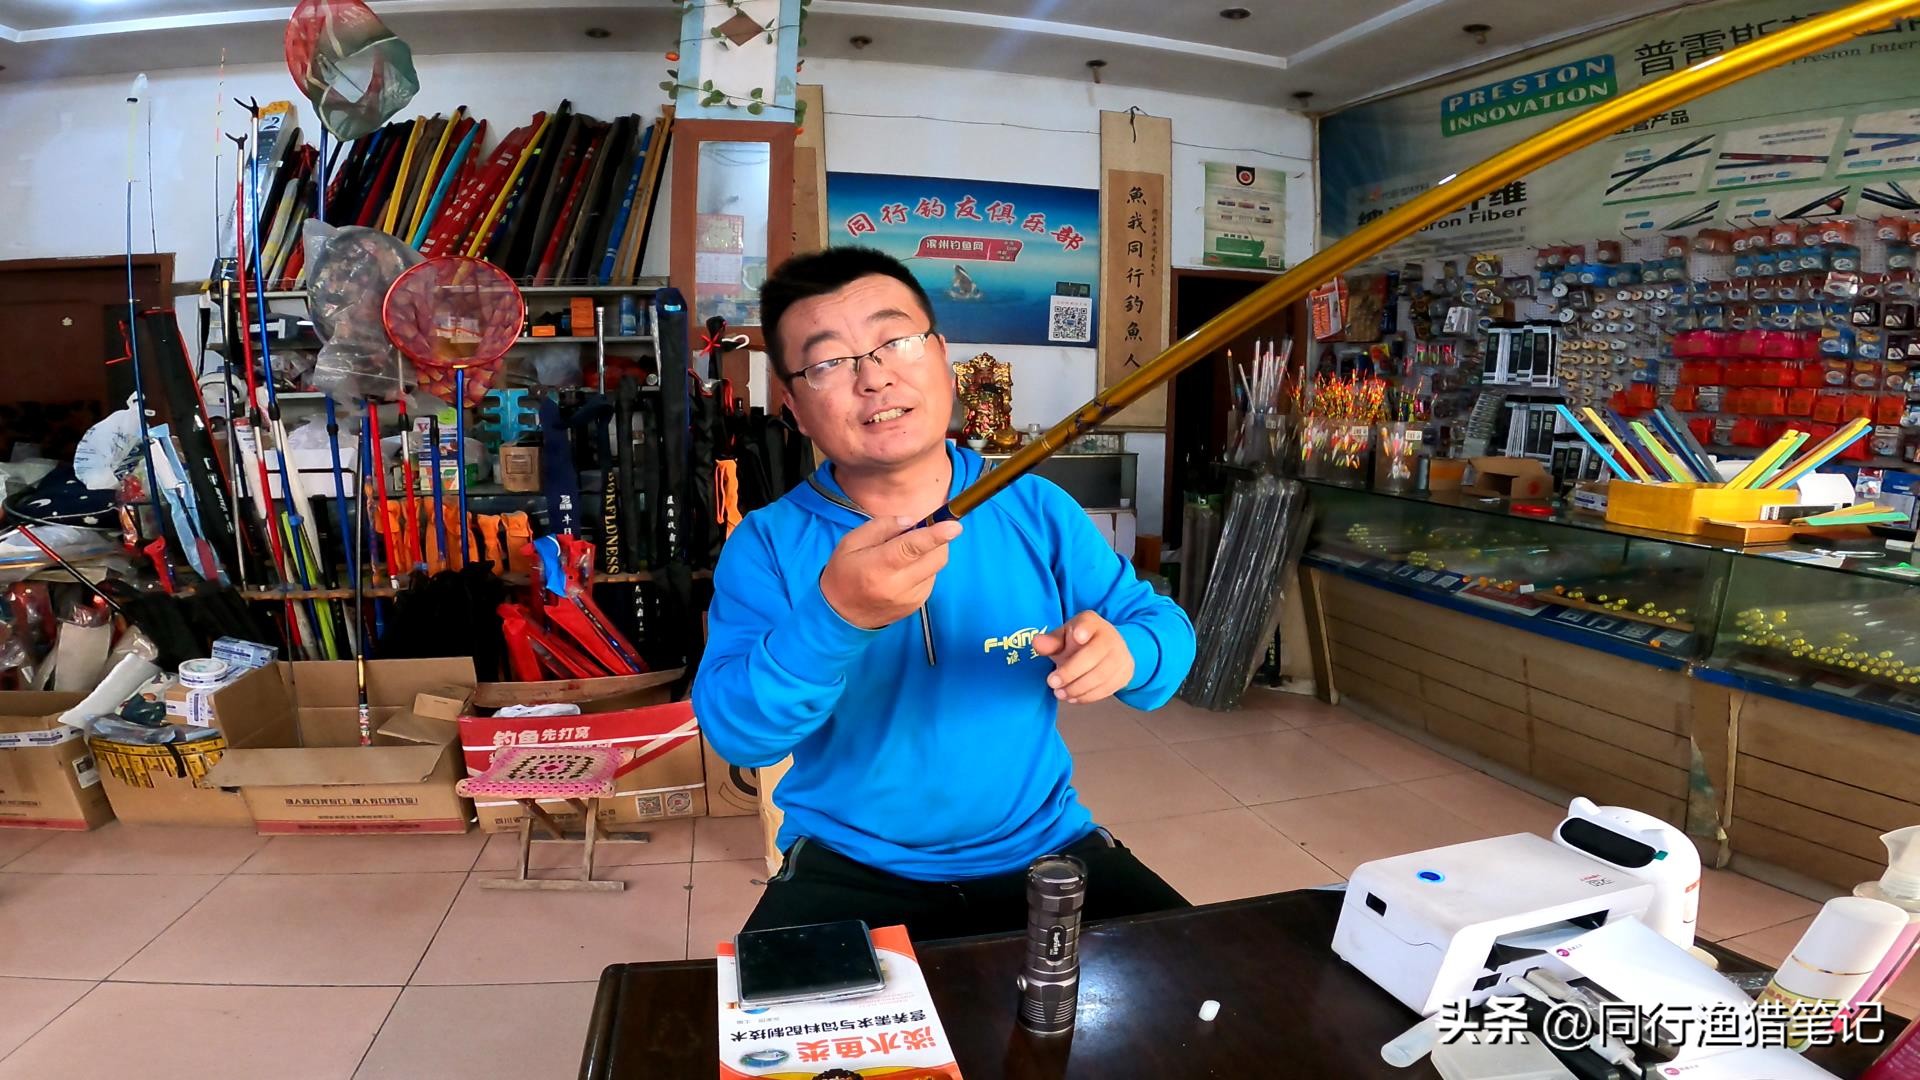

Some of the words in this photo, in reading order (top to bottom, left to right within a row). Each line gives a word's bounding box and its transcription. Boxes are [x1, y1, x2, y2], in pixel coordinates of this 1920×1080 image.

[1791, 47, 1862, 65] reston
[1869, 39, 1920, 55] Inter
[1449, 58, 1605, 112] PRESTON
[1450, 82, 1609, 131] INNOVATION
[1615, 109, 1690, 135] 营产品
[846, 195, 1087, 253] 同行钓友俱乐部
[1468, 206, 1527, 224] Fiber
[926, 239, 985, 252] 滨州钓鱼网
[492, 726, 591, 747] 钓鱼先打窝
[730, 1009, 926, 1042] 营养需求与饲料配制技术
[796, 1026, 939, 1062] 淡水鱼类
